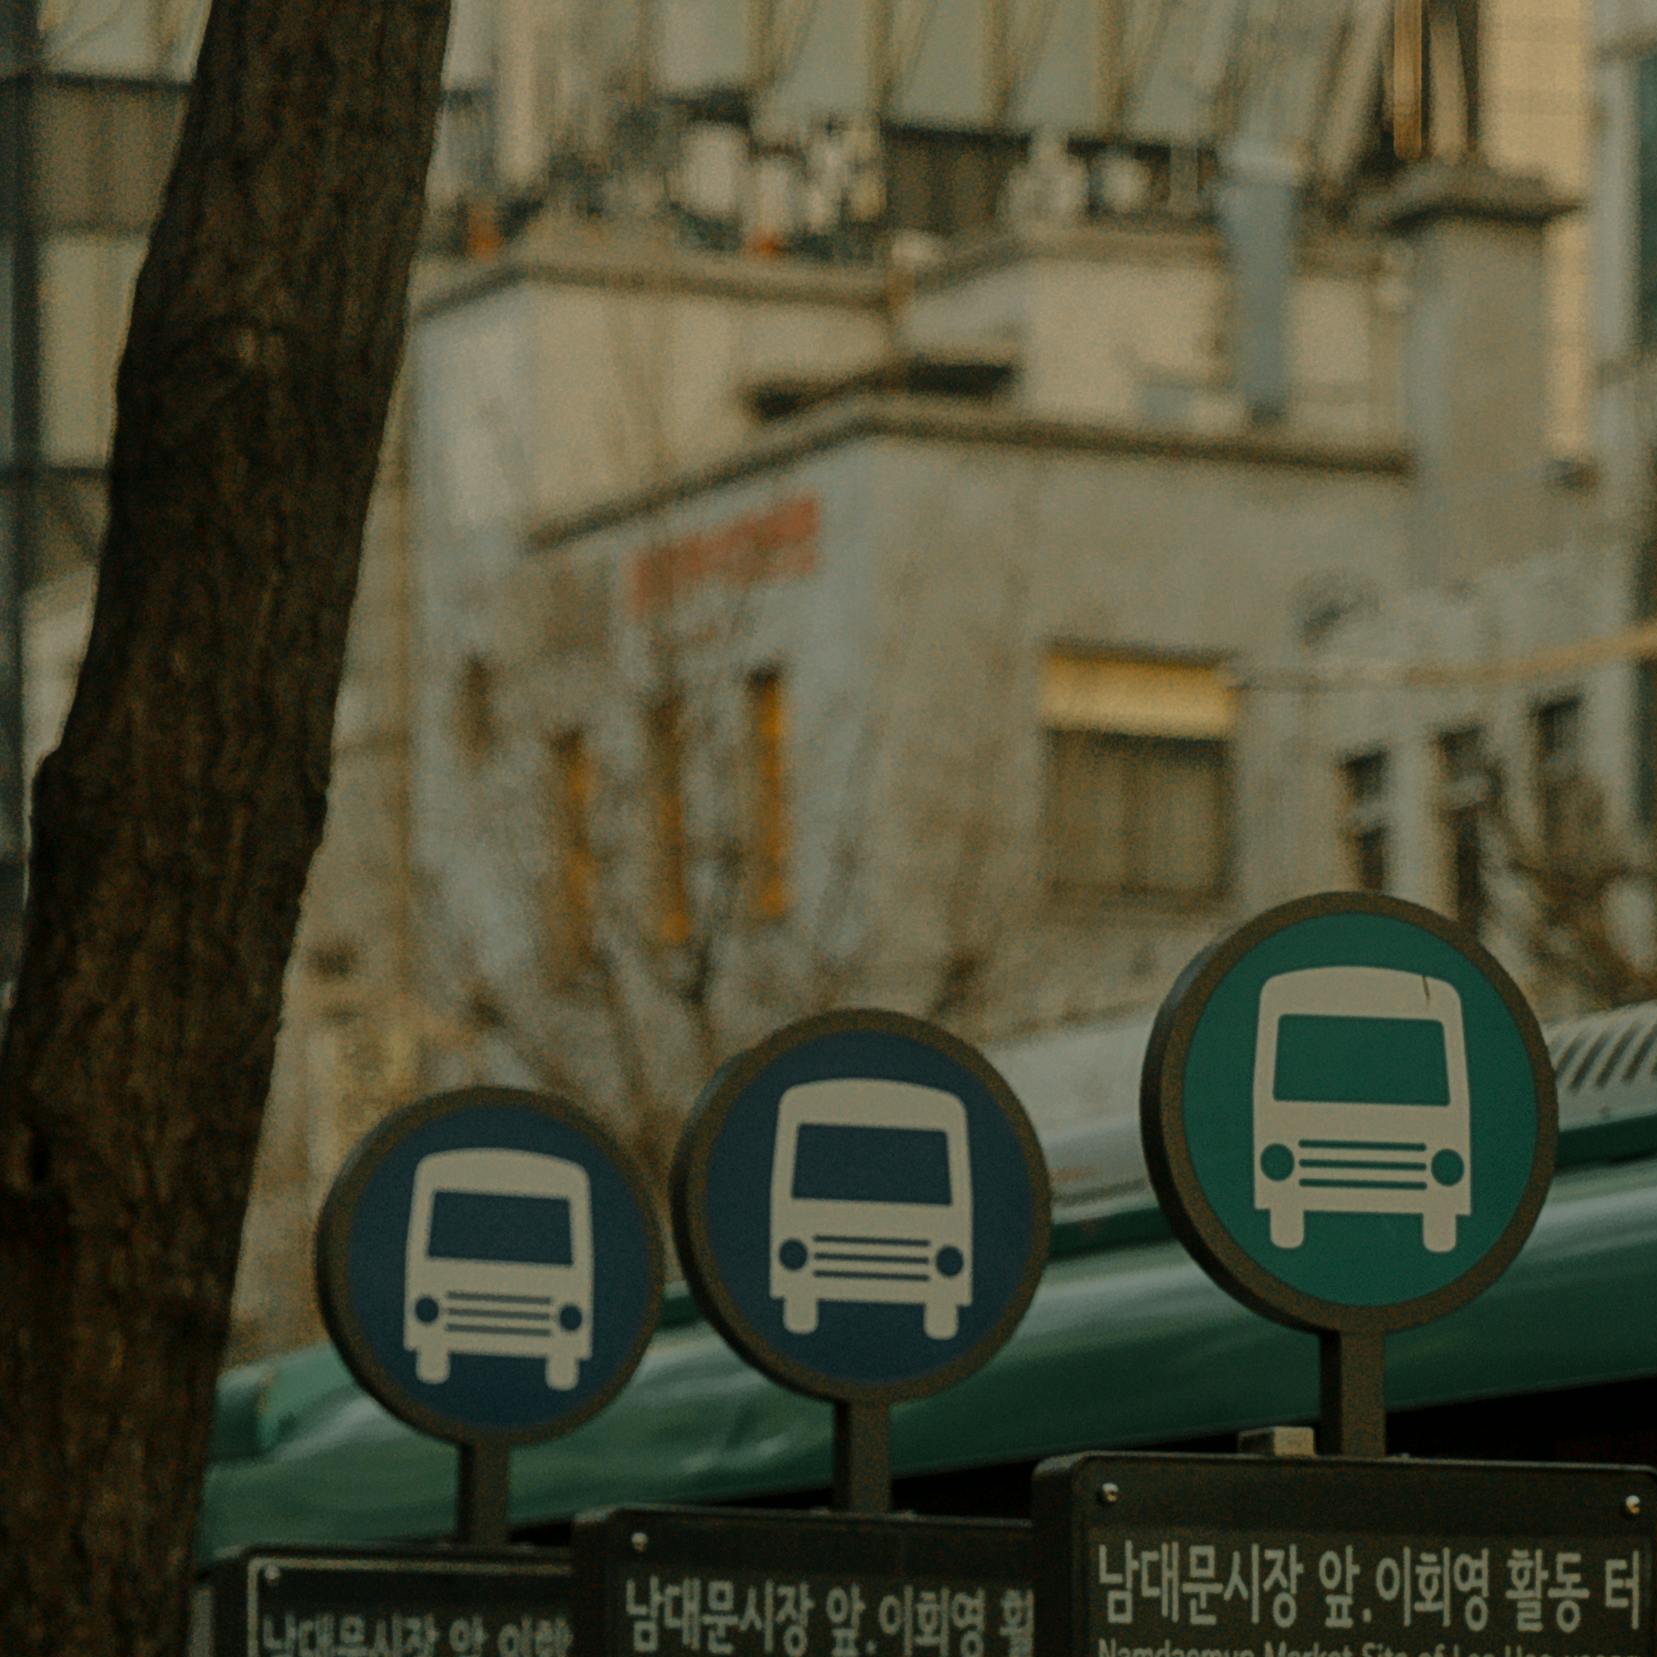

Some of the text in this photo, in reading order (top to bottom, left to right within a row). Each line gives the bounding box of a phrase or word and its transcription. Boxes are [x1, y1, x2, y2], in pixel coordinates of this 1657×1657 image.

[1099, 1539, 1303, 1628] 남대문시장
[1506, 1548, 1590, 1633] 활동
[1605, 1551, 1640, 1631] 터
